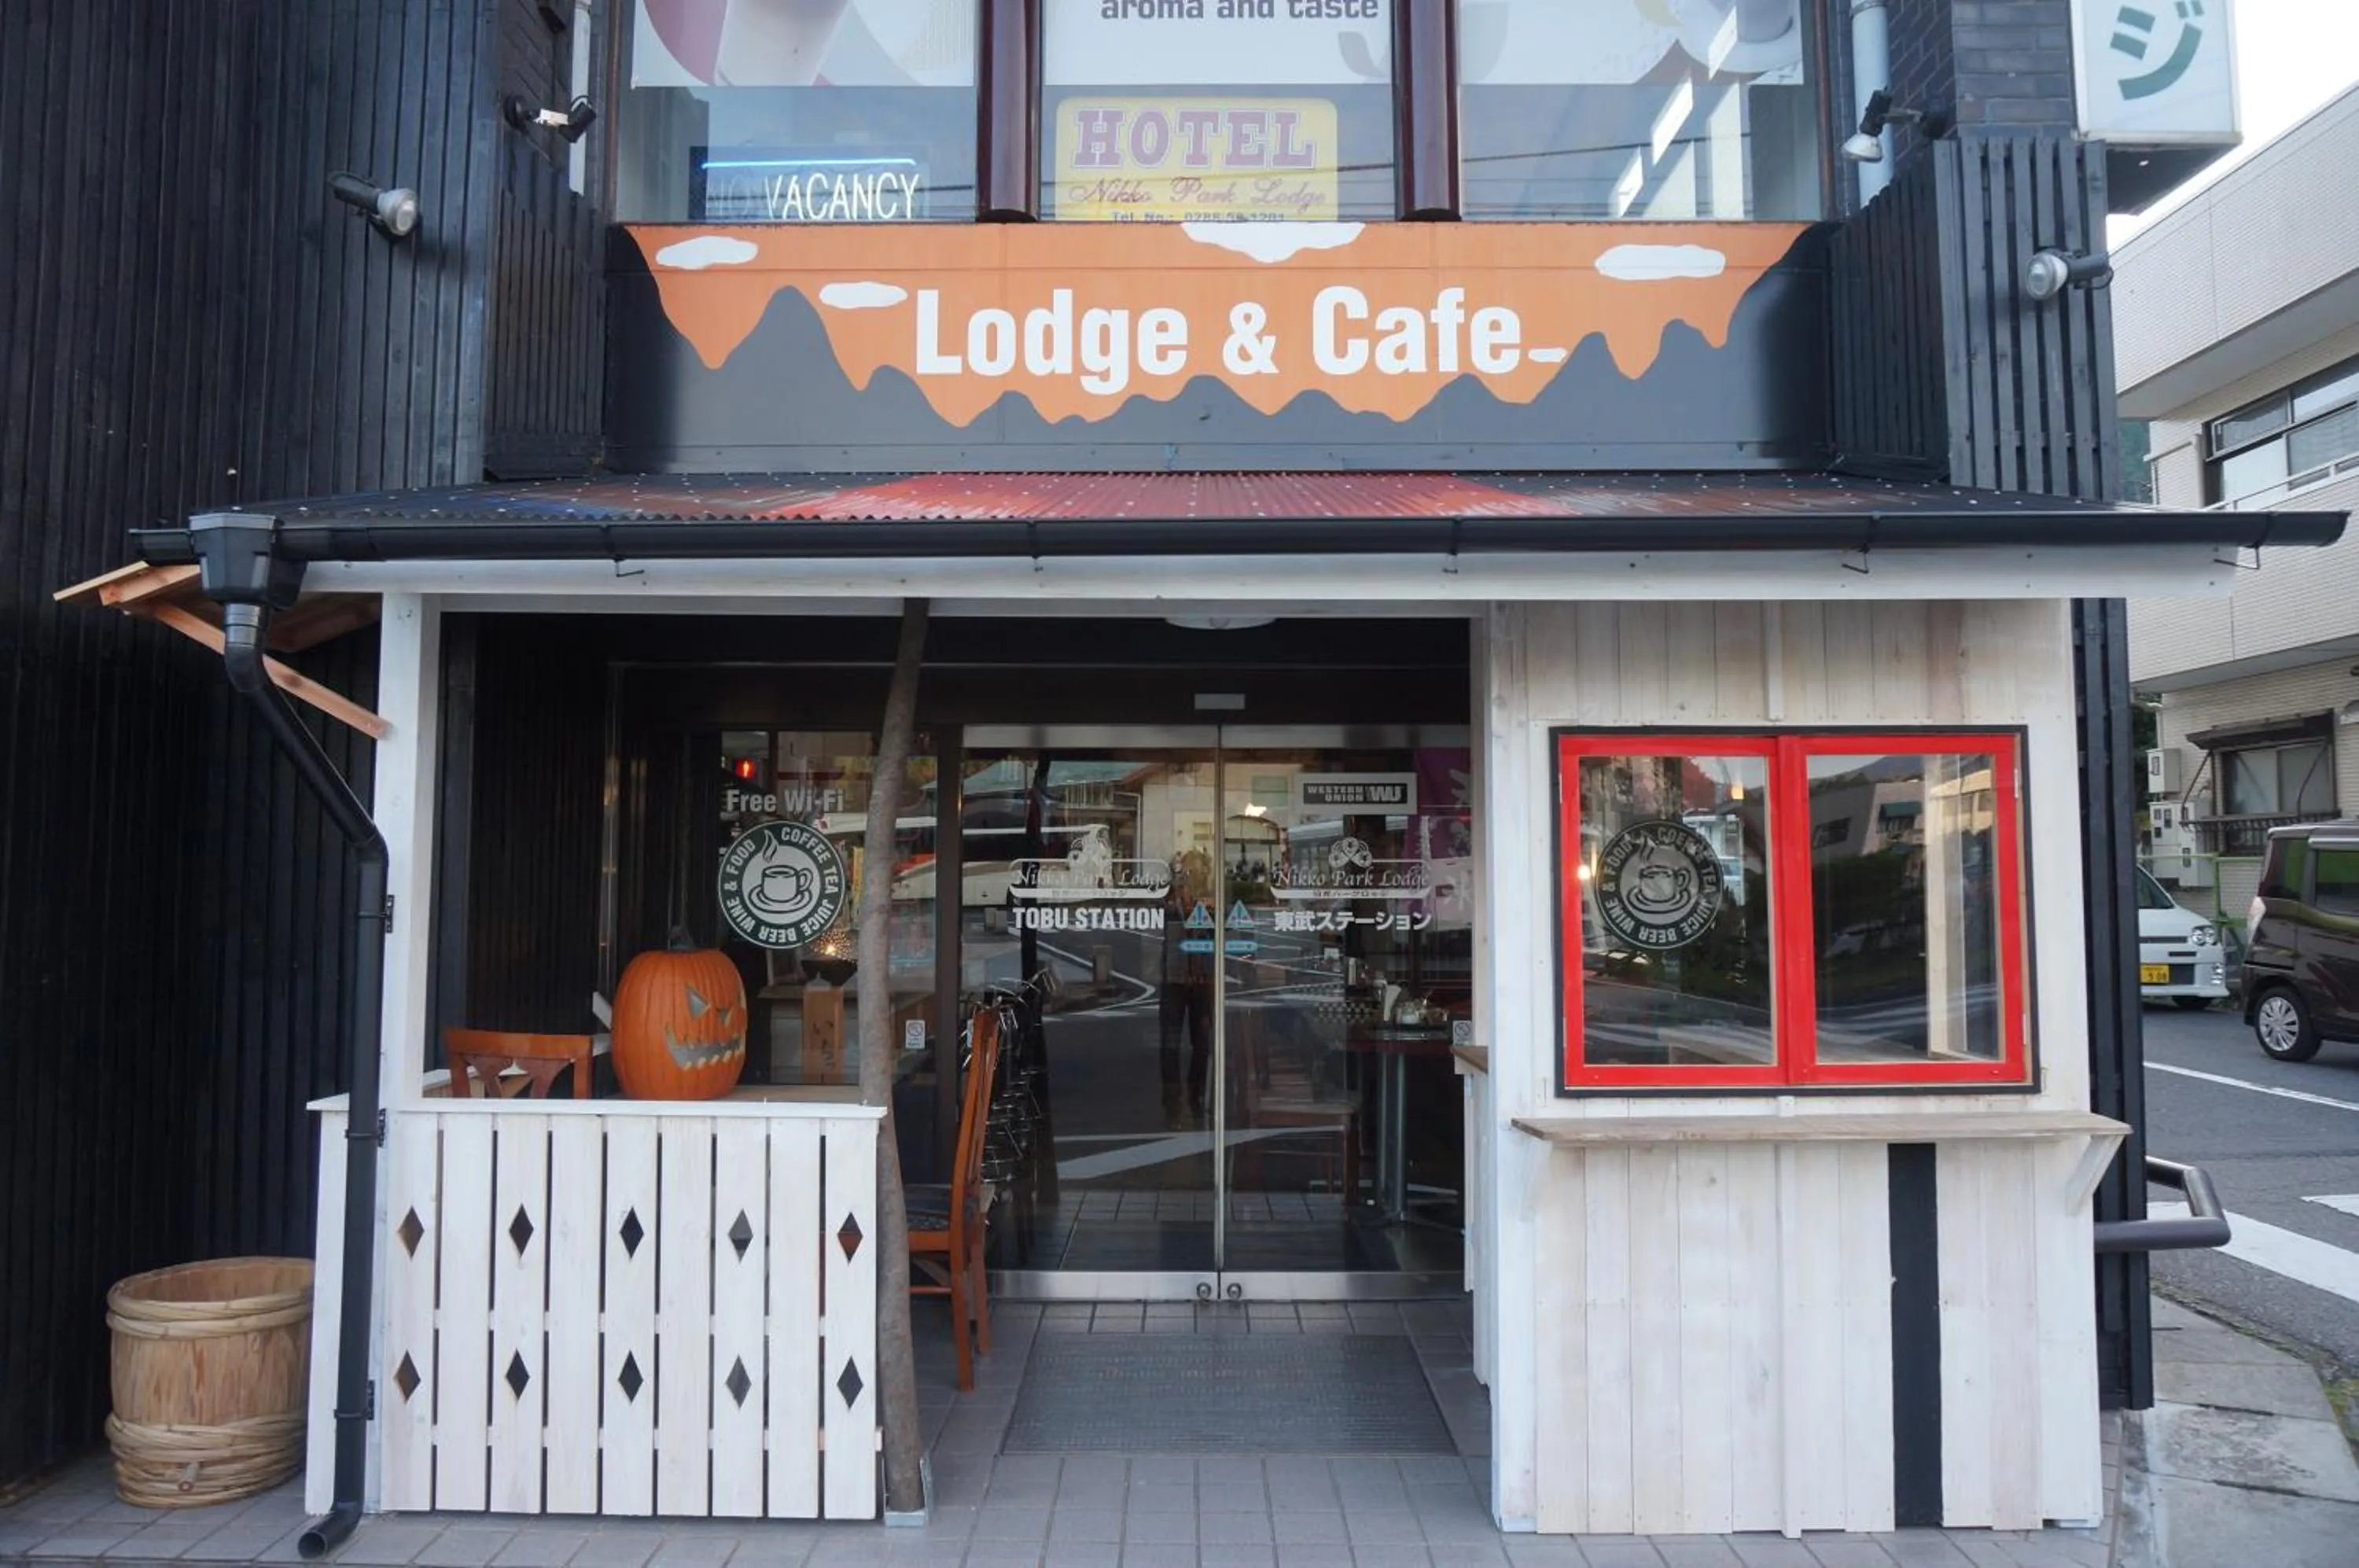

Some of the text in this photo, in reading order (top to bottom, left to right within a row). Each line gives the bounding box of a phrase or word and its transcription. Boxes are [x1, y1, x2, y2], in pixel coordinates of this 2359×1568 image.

[1101, 0, 1379, 20] aroma and taste
[1071, 107, 1318, 171] HOTEL
[765, 172, 919, 220] VACANCY
[1069, 176, 1327, 215] Nikko Park Lodge
[915, 285, 1522, 395] Lodge & Cafe
[727, 789, 844, 812] Free Wi-Fi
[1603, 839, 1633, 876] FOOD
[723, 826, 839, 943] COFFEE TEA JUICE BEER WINE & FOOD
[1118, 867, 1168, 893] Lodge
[1273, 866, 1429, 889] Nikko Park Lodge
[1702, 864, 1717, 893] TEA
[1012, 907, 1165, 929] TOBU STATION
[1274, 911, 1432, 932] 東武ステーション
[1605, 896, 1636, 934] WINE
[1679, 896, 1713, 937] JUICE
[1638, 926, 1677, 943] BEER
